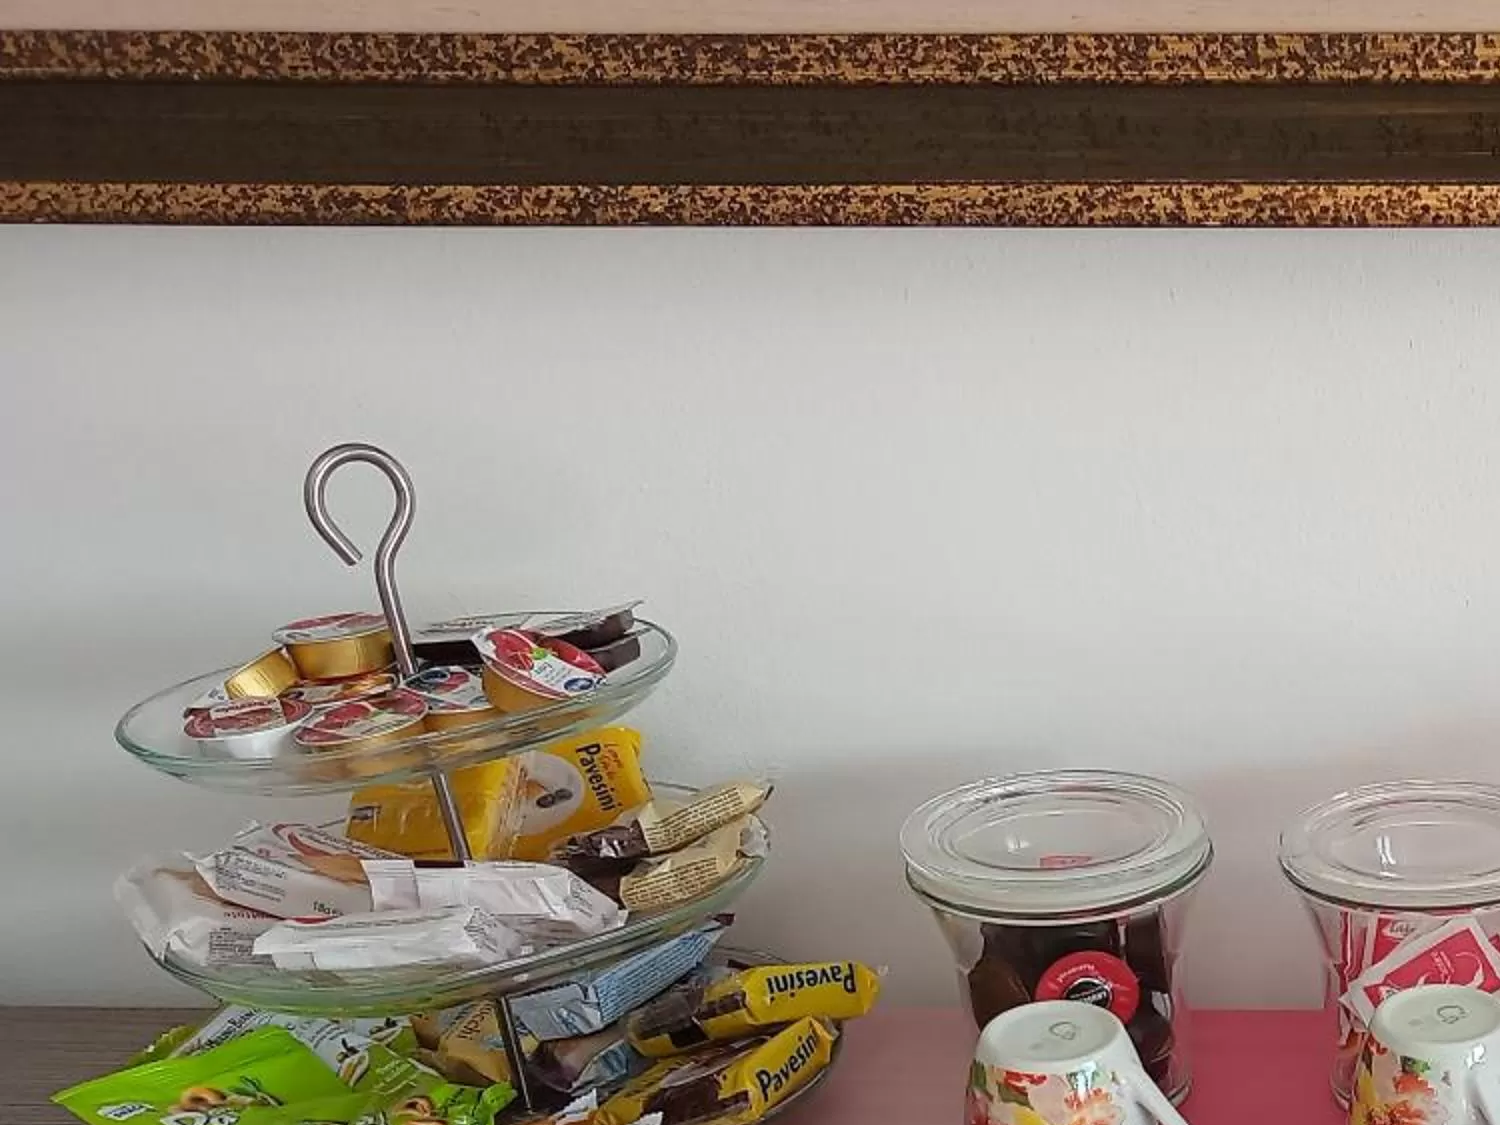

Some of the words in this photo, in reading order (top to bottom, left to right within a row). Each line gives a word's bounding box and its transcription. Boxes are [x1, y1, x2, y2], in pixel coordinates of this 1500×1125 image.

[575, 743, 623, 811] Pavesini
[766, 961, 857, 1004] Pavesini
[756, 1028, 818, 1102] Pavesin
